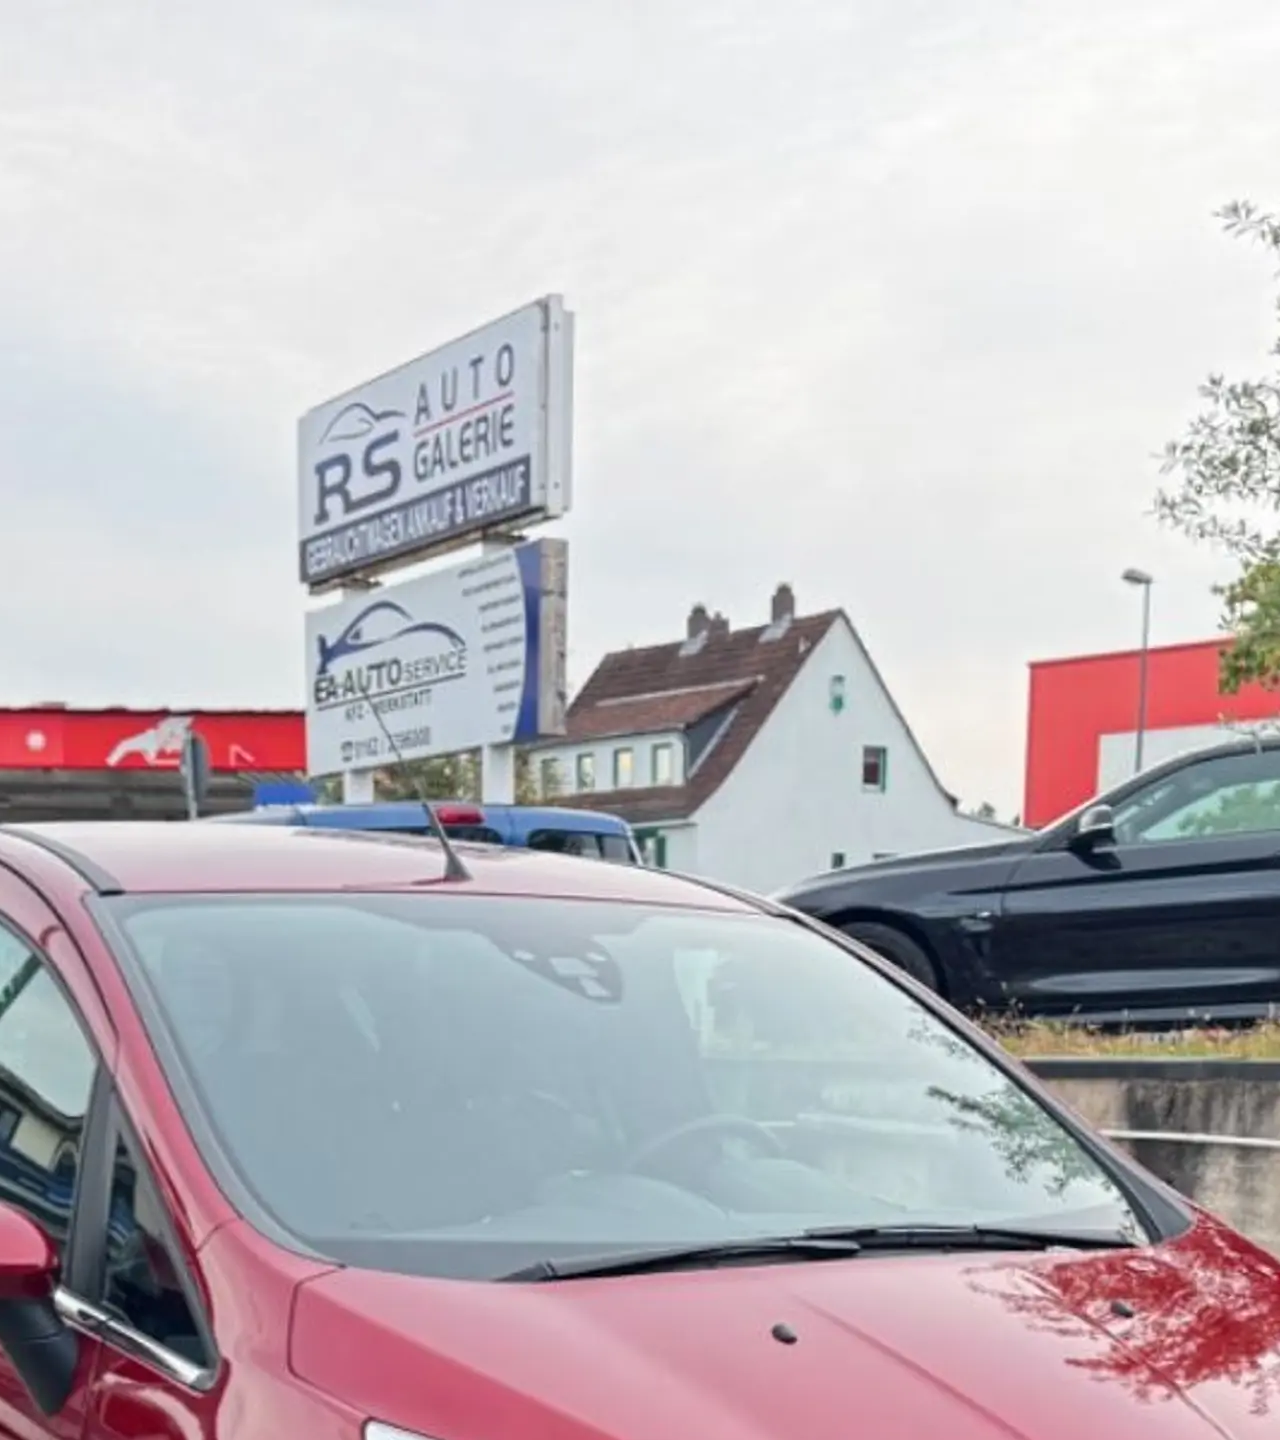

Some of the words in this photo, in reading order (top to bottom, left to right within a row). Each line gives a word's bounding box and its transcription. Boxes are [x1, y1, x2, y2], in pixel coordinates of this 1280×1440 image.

[413, 343, 516, 426] AUTO
[314, 430, 402, 527] RS
[413, 404, 516, 482] GALERIE
